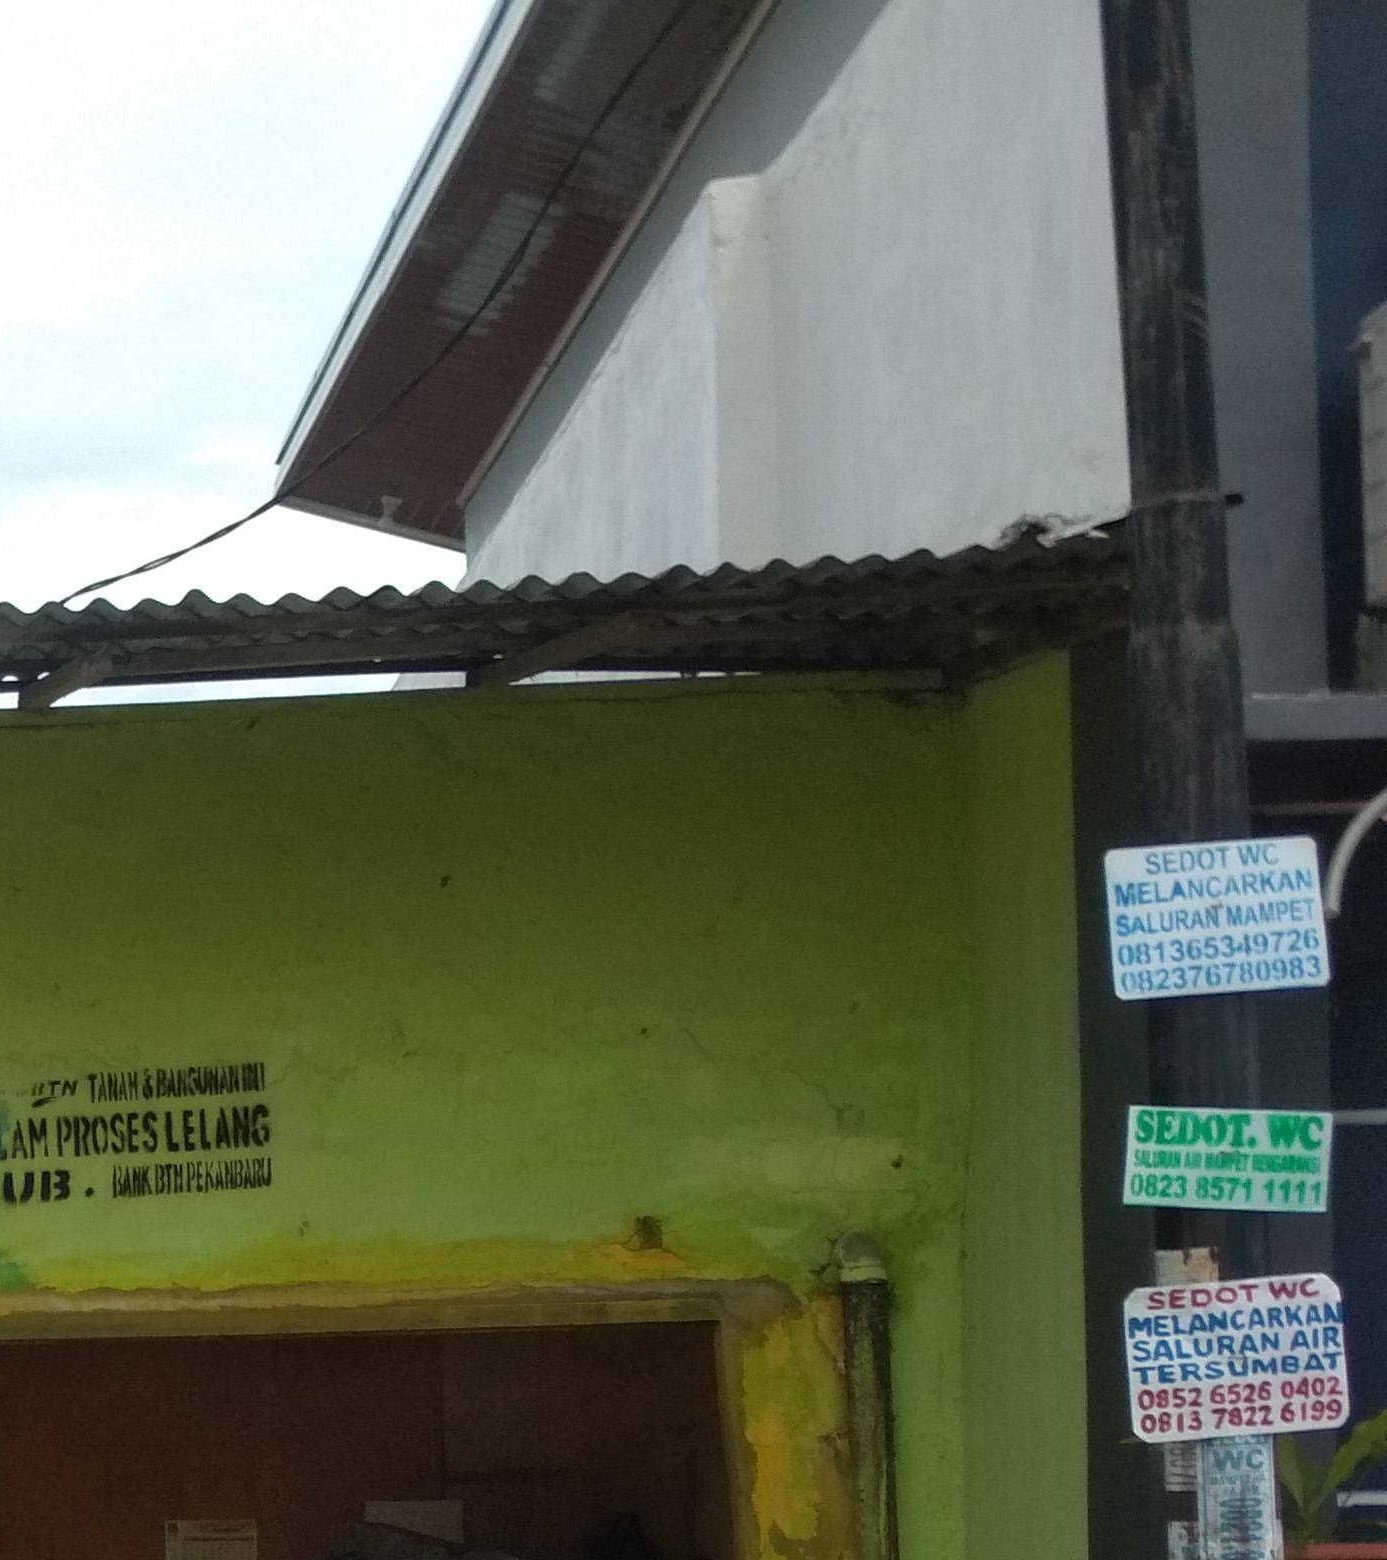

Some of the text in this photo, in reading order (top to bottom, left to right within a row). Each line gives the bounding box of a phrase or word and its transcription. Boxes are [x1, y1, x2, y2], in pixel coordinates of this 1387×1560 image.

[1145, 843, 1279, 875] SEDOT WC
[1114, 868, 1313, 908] MELANCARKAN
[1115, 899, 1314, 937] SALURAN MAMPET
[1117, 928, 1320, 966] 081365349726
[1121, 955, 1322, 993] 082376780983
[87, 1070, 139, 1104] TANAH
[55, 1109, 159, 1158] PROSES
[164, 1103, 271, 1152] LELANG
[1267, 1113, 1325, 1151] WC
[112, 1164, 153, 1199] BANK
[155, 1162, 183, 1195] BTN
[186, 1156, 273, 1193] PEKANBARU
[1129, 1173, 1321, 1204] 0823 8571 1111
[1147, 1278, 1320, 1311] SEDOT WC
[1128, 1301, 1345, 1339] MELANCARKAN
[1132, 1326, 1342, 1363] SALURAN AIR
[1132, 1351, 1343, 1386] TERSUMBAT
[1137, 1376, 1343, 1411] 0852 6526 0402
[1140, 1399, 1343, 1435] 0813 7822 6199
[1211, 1448, 1265, 1471] WC
